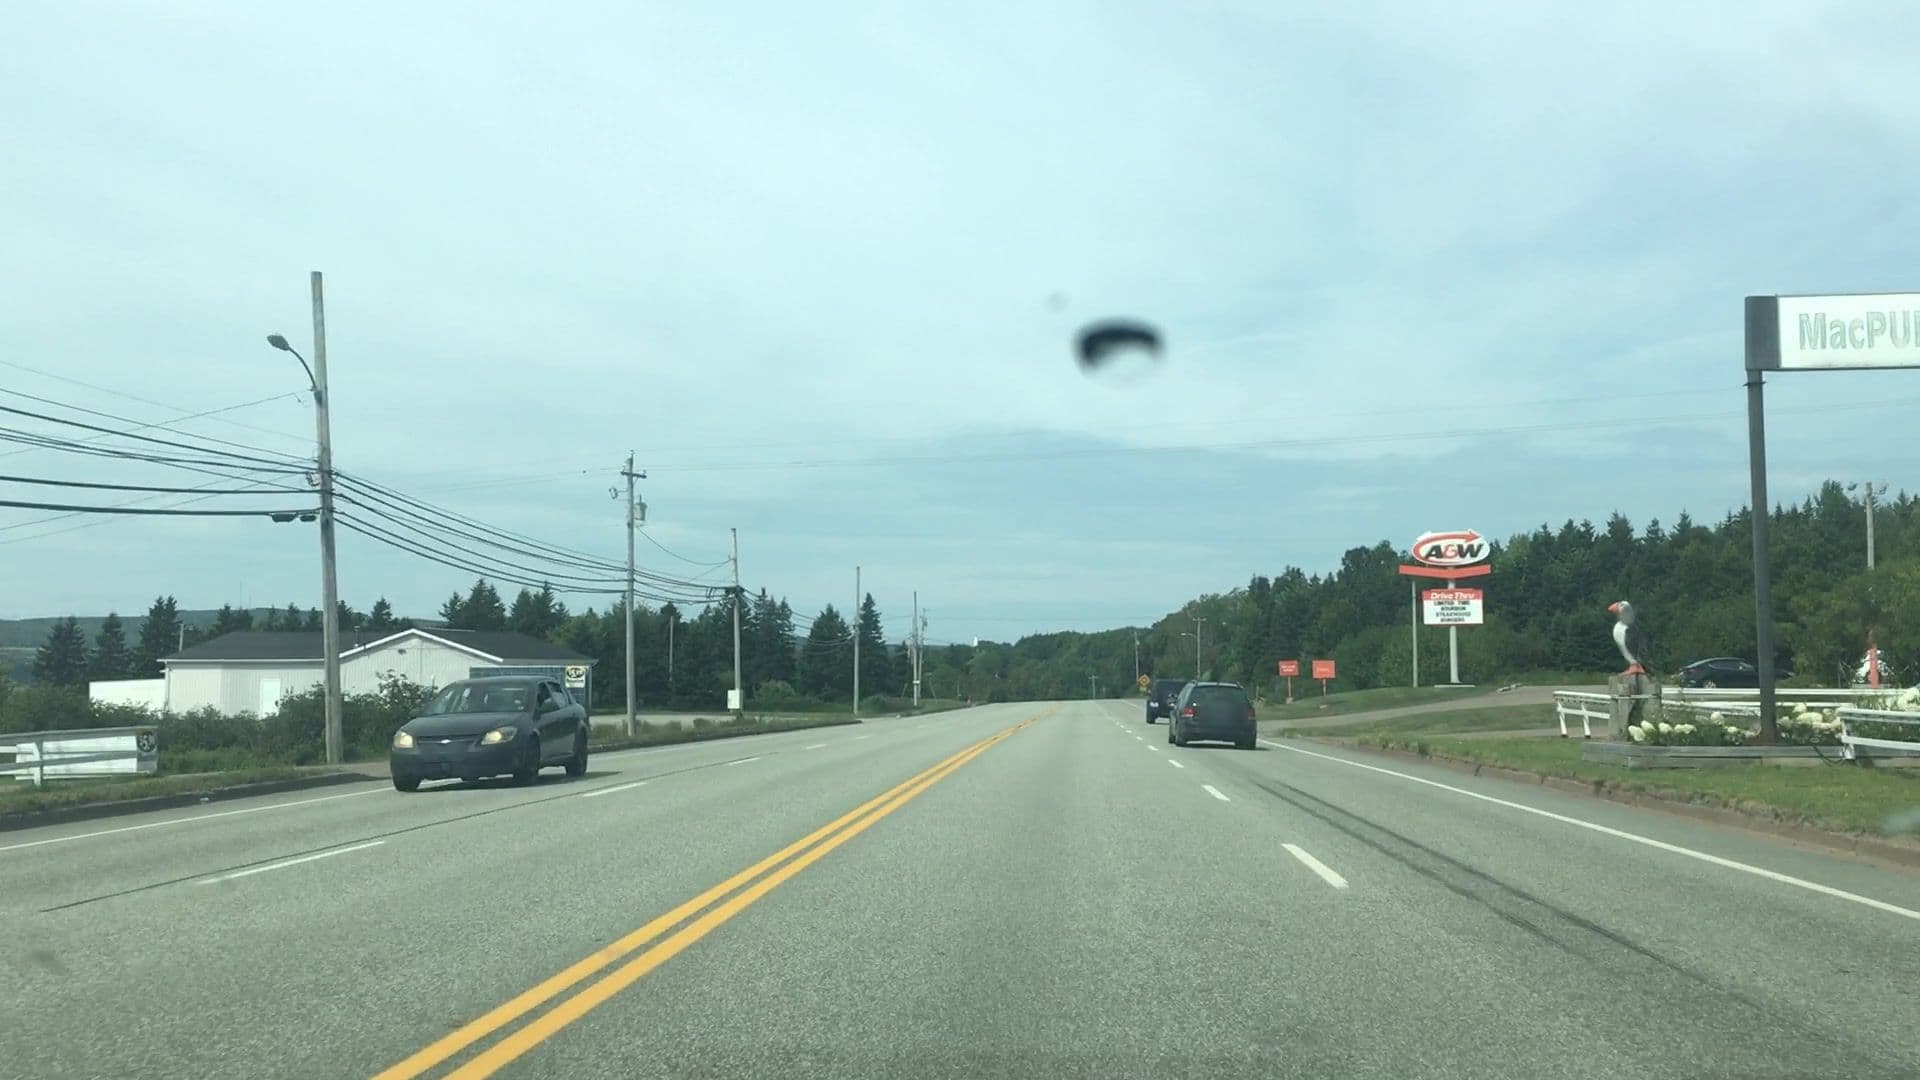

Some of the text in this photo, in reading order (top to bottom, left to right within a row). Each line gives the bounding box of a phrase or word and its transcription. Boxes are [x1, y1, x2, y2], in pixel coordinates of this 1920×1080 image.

[1425, 543, 1483, 559] A&W
[1430, 591, 1475, 599] Drive Thru
